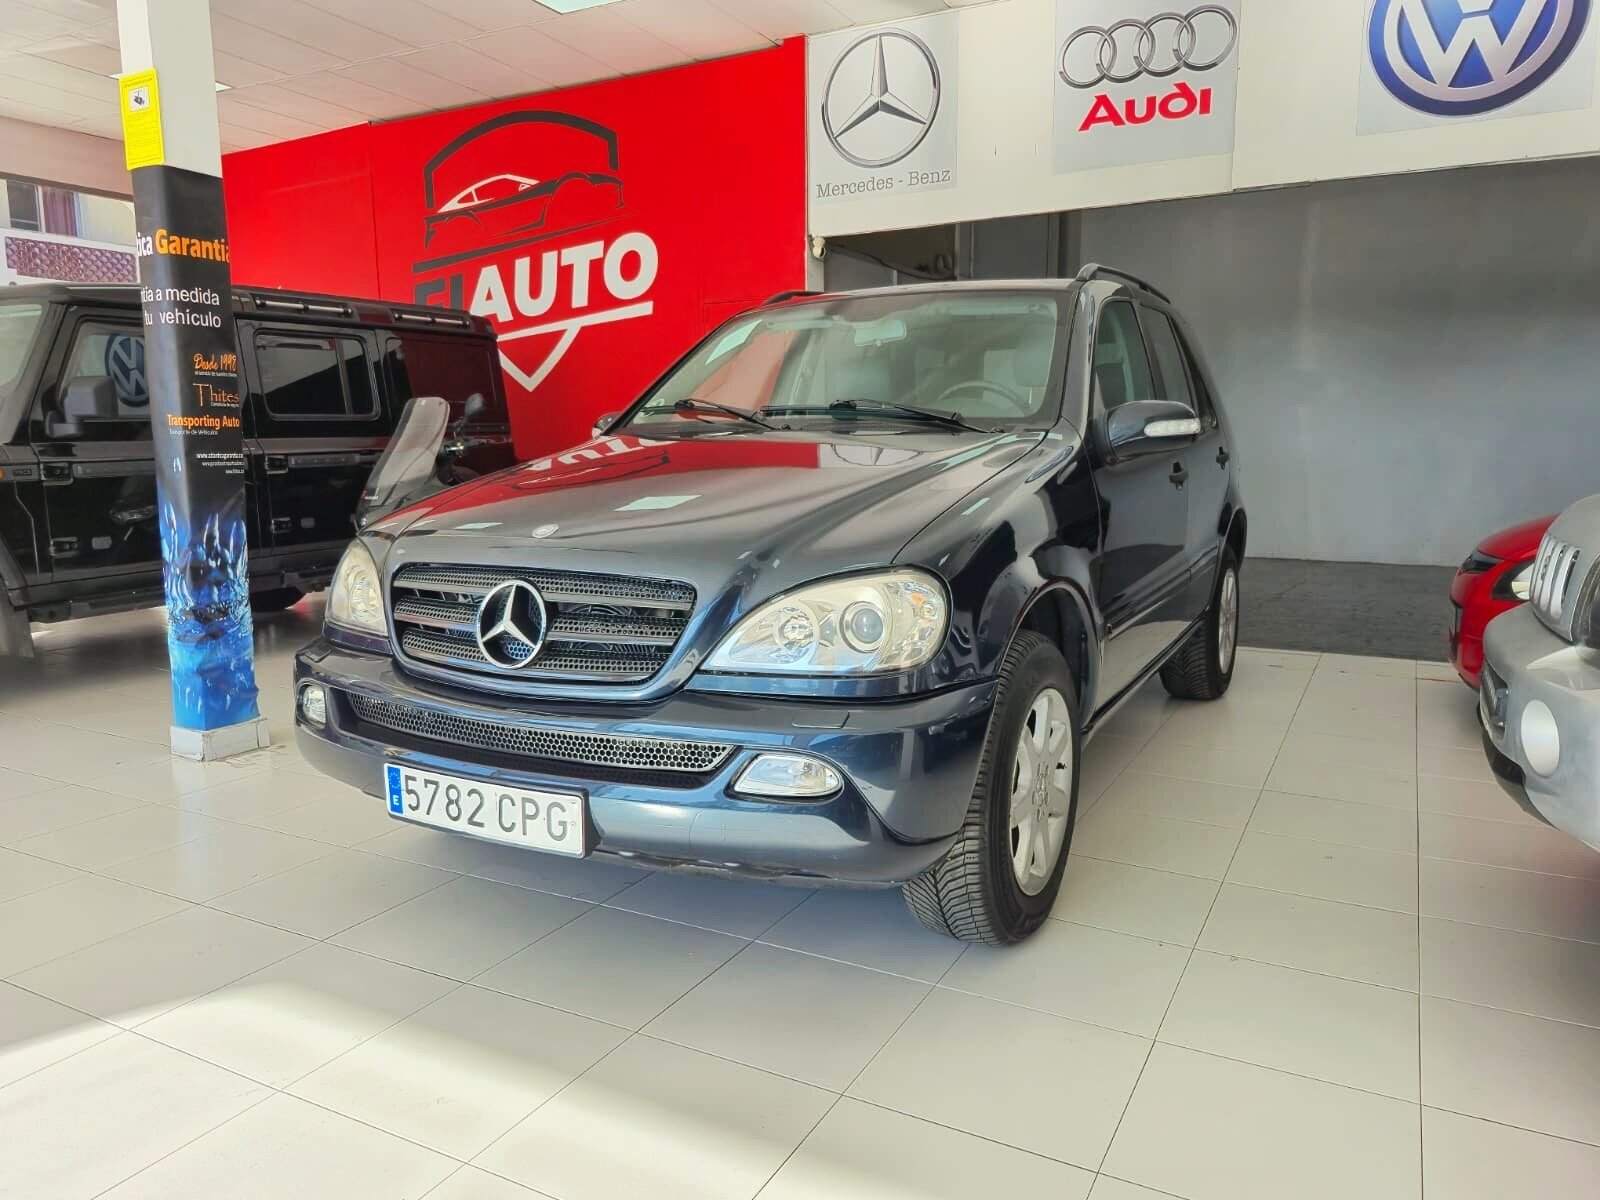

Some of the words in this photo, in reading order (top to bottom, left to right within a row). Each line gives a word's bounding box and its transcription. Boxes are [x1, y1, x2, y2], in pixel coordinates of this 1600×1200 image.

[1078, 82, 1212, 132] Audi
[815, 176, 894, 198] Mercedes
[908, 170, 951, 186] Benz
[156, 289, 162, 301] a
[166, 287, 220, 306] medida
[145, 310, 153, 325] tu
[193, 353, 219, 370] Desde
[167, 414, 220, 430] Transporting
[222, 416, 240, 428] Auto
[393, 795, 399, 806] E
[404, 774, 485, 828] 5782
[498, 793, 568, 841] CPG
